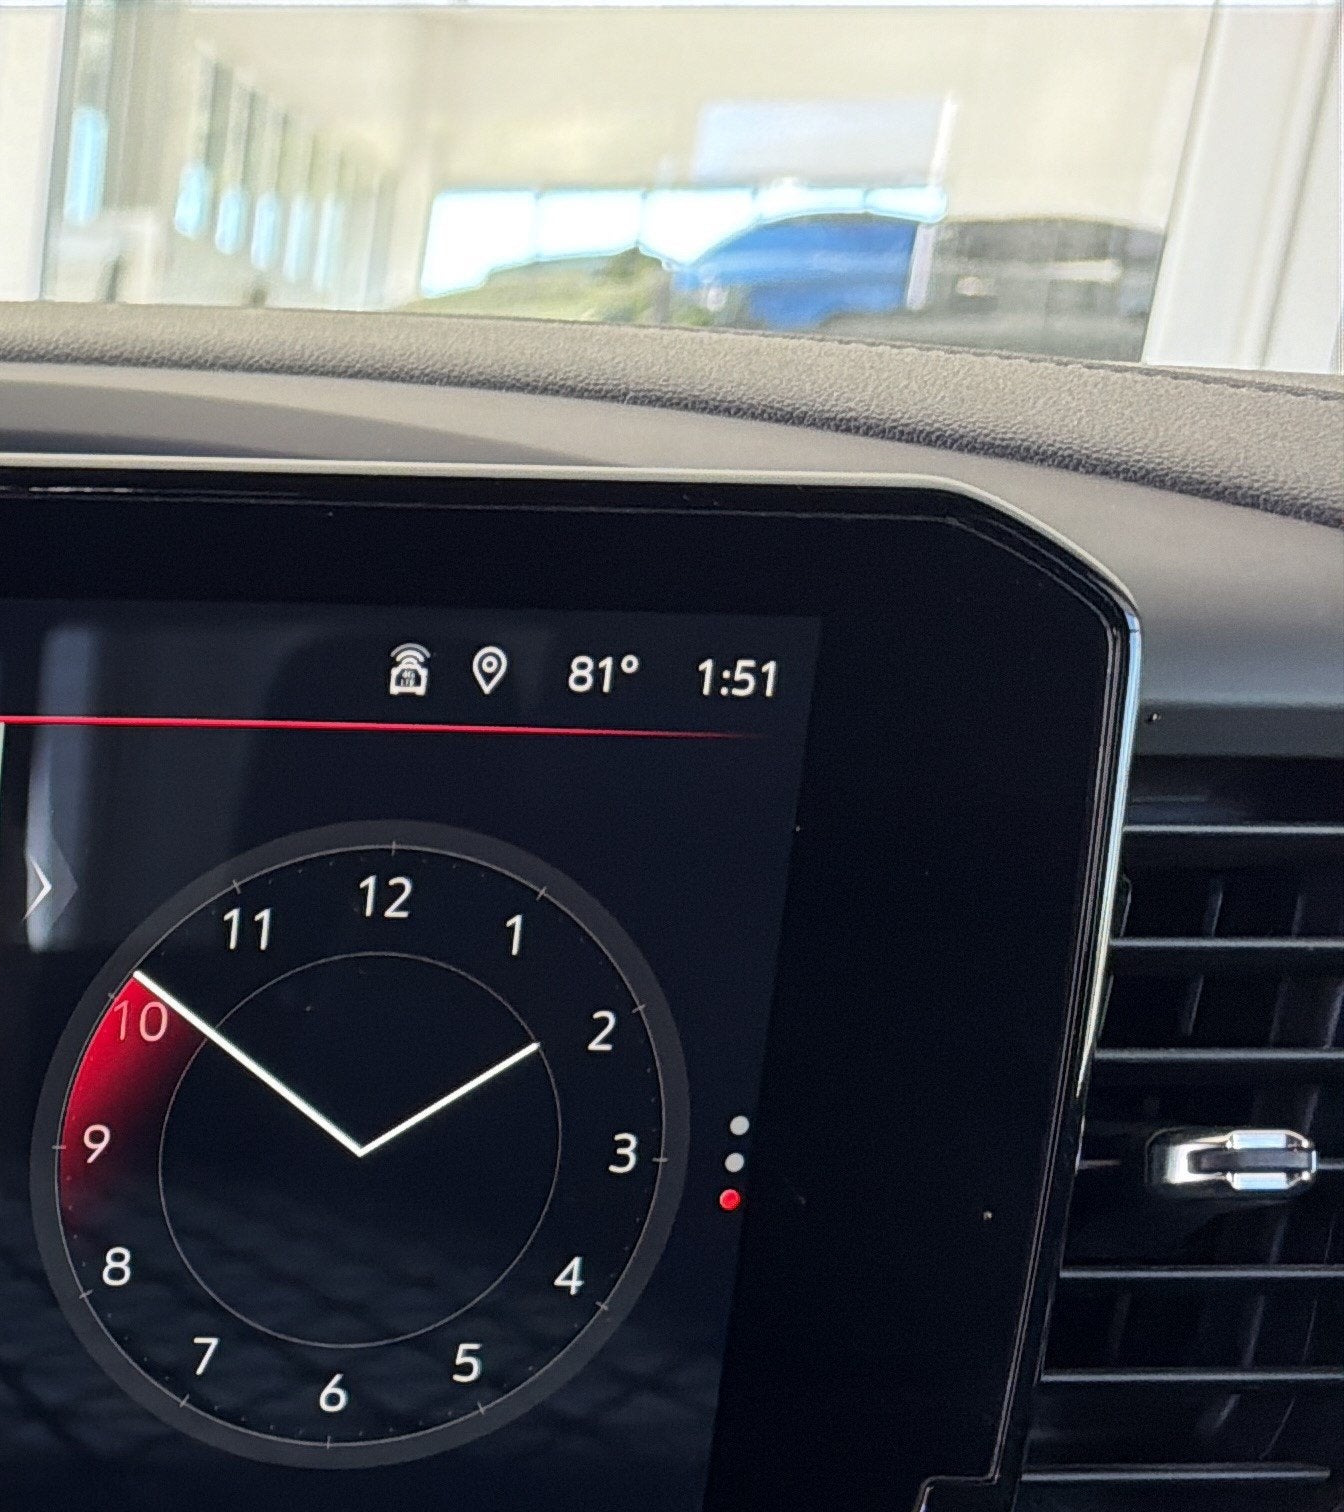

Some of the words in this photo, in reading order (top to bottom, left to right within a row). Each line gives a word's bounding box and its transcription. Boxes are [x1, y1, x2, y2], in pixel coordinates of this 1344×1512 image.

[568, 653, 640, 695] 81°
[697, 656, 779, 697] 1:51
[359, 875, 413, 918] 12
[223, 908, 272, 950] 11
[507, 914, 525, 956] 1
[112, 1001, 169, 1042] 10
[587, 1011, 617, 1051] 2
[83, 1123, 111, 1162] 9
[608, 1132, 639, 1174] 3
[102, 1246, 132, 1286] 8
[554, 1255, 585, 1296] 4
[193, 1336, 220, 1375] 7
[453, 1342, 483, 1384] 5
[319, 1374, 348, 1412] 6
